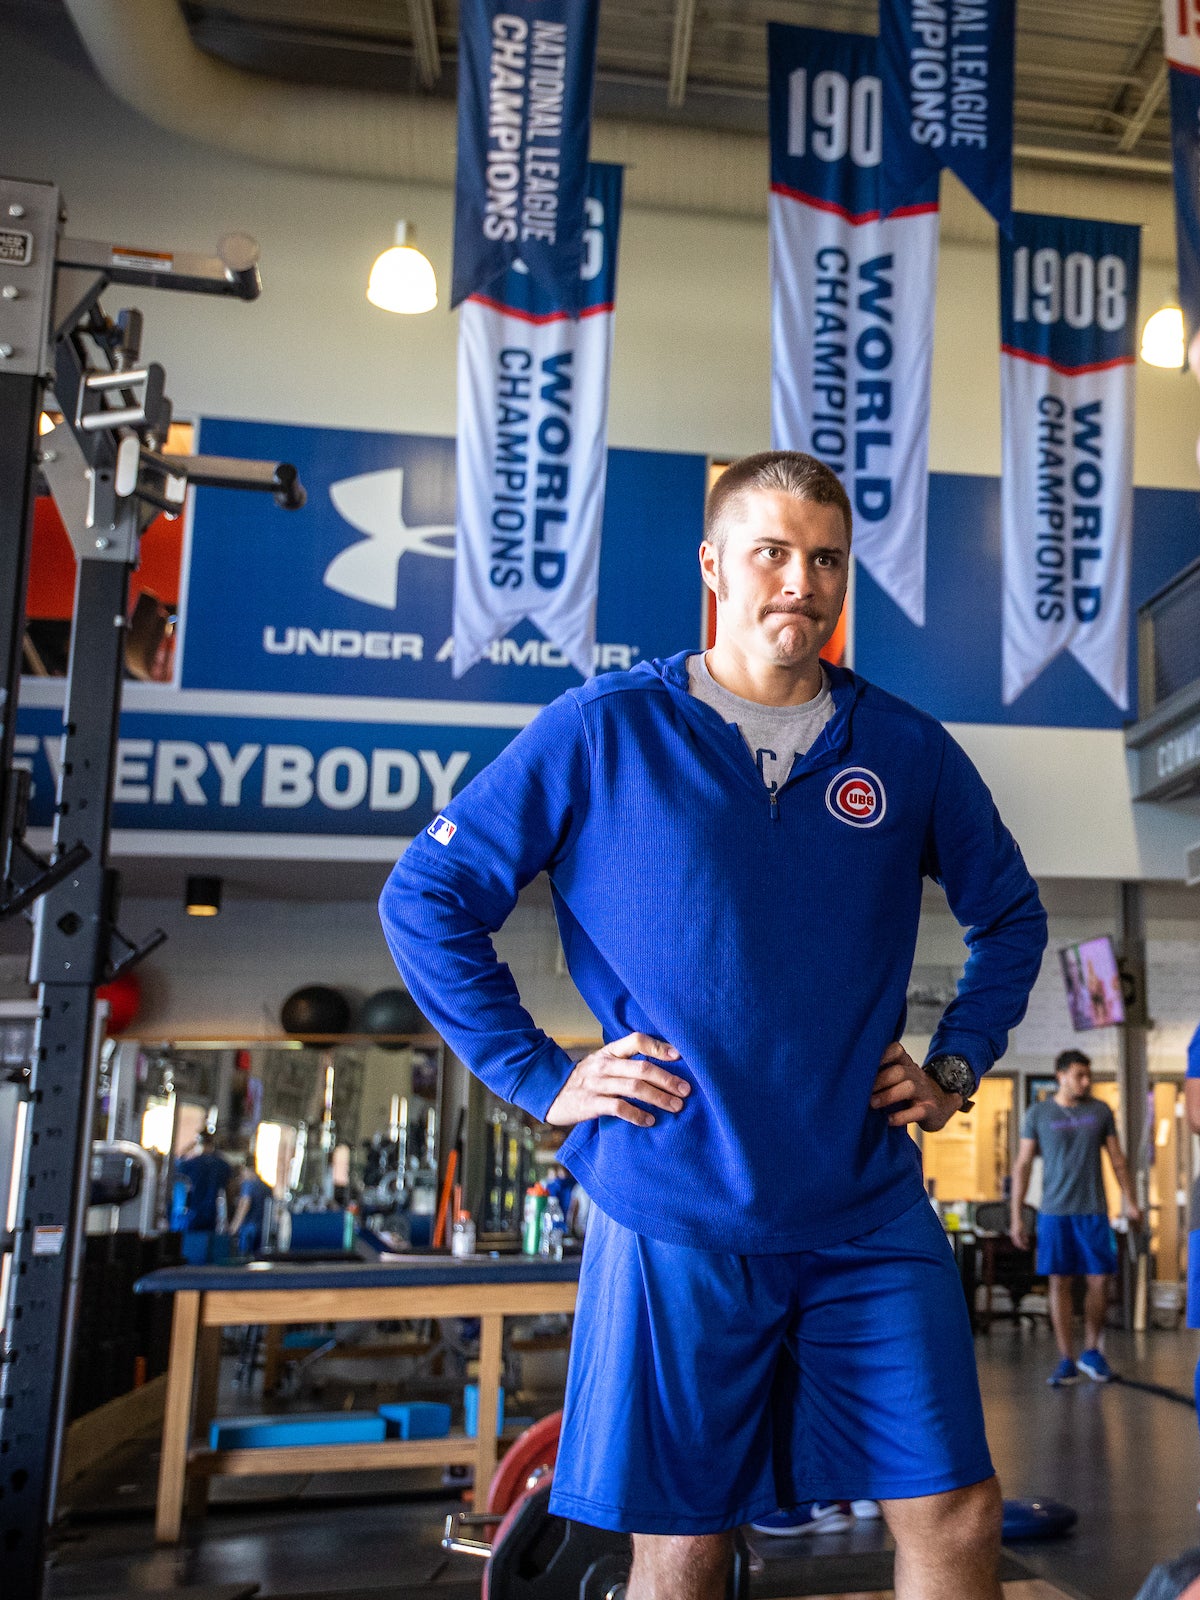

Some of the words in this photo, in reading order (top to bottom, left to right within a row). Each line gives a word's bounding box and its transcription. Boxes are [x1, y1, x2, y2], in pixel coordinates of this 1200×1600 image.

[482, 12, 529, 242] CHAMPIONS
[525, 19, 568, 142] NATIONAL
[950, 44, 988, 149] LEAGUE
[520, 147, 560, 245] LEAGUE
[1012, 246, 1128, 332] 1908
[489, 348, 532, 590] CHAMPIONS
[532, 351, 574, 590] WORLD
[811, 246, 850, 474] CHAMPIO
[855, 252, 894, 522] WORLD
[1036, 393, 1067, 623] CHAMPIONS
[1071, 399, 1104, 625] WORLD
[264, 626, 423, 661] UNDER
[435, 636, 632, 670] AMOR
